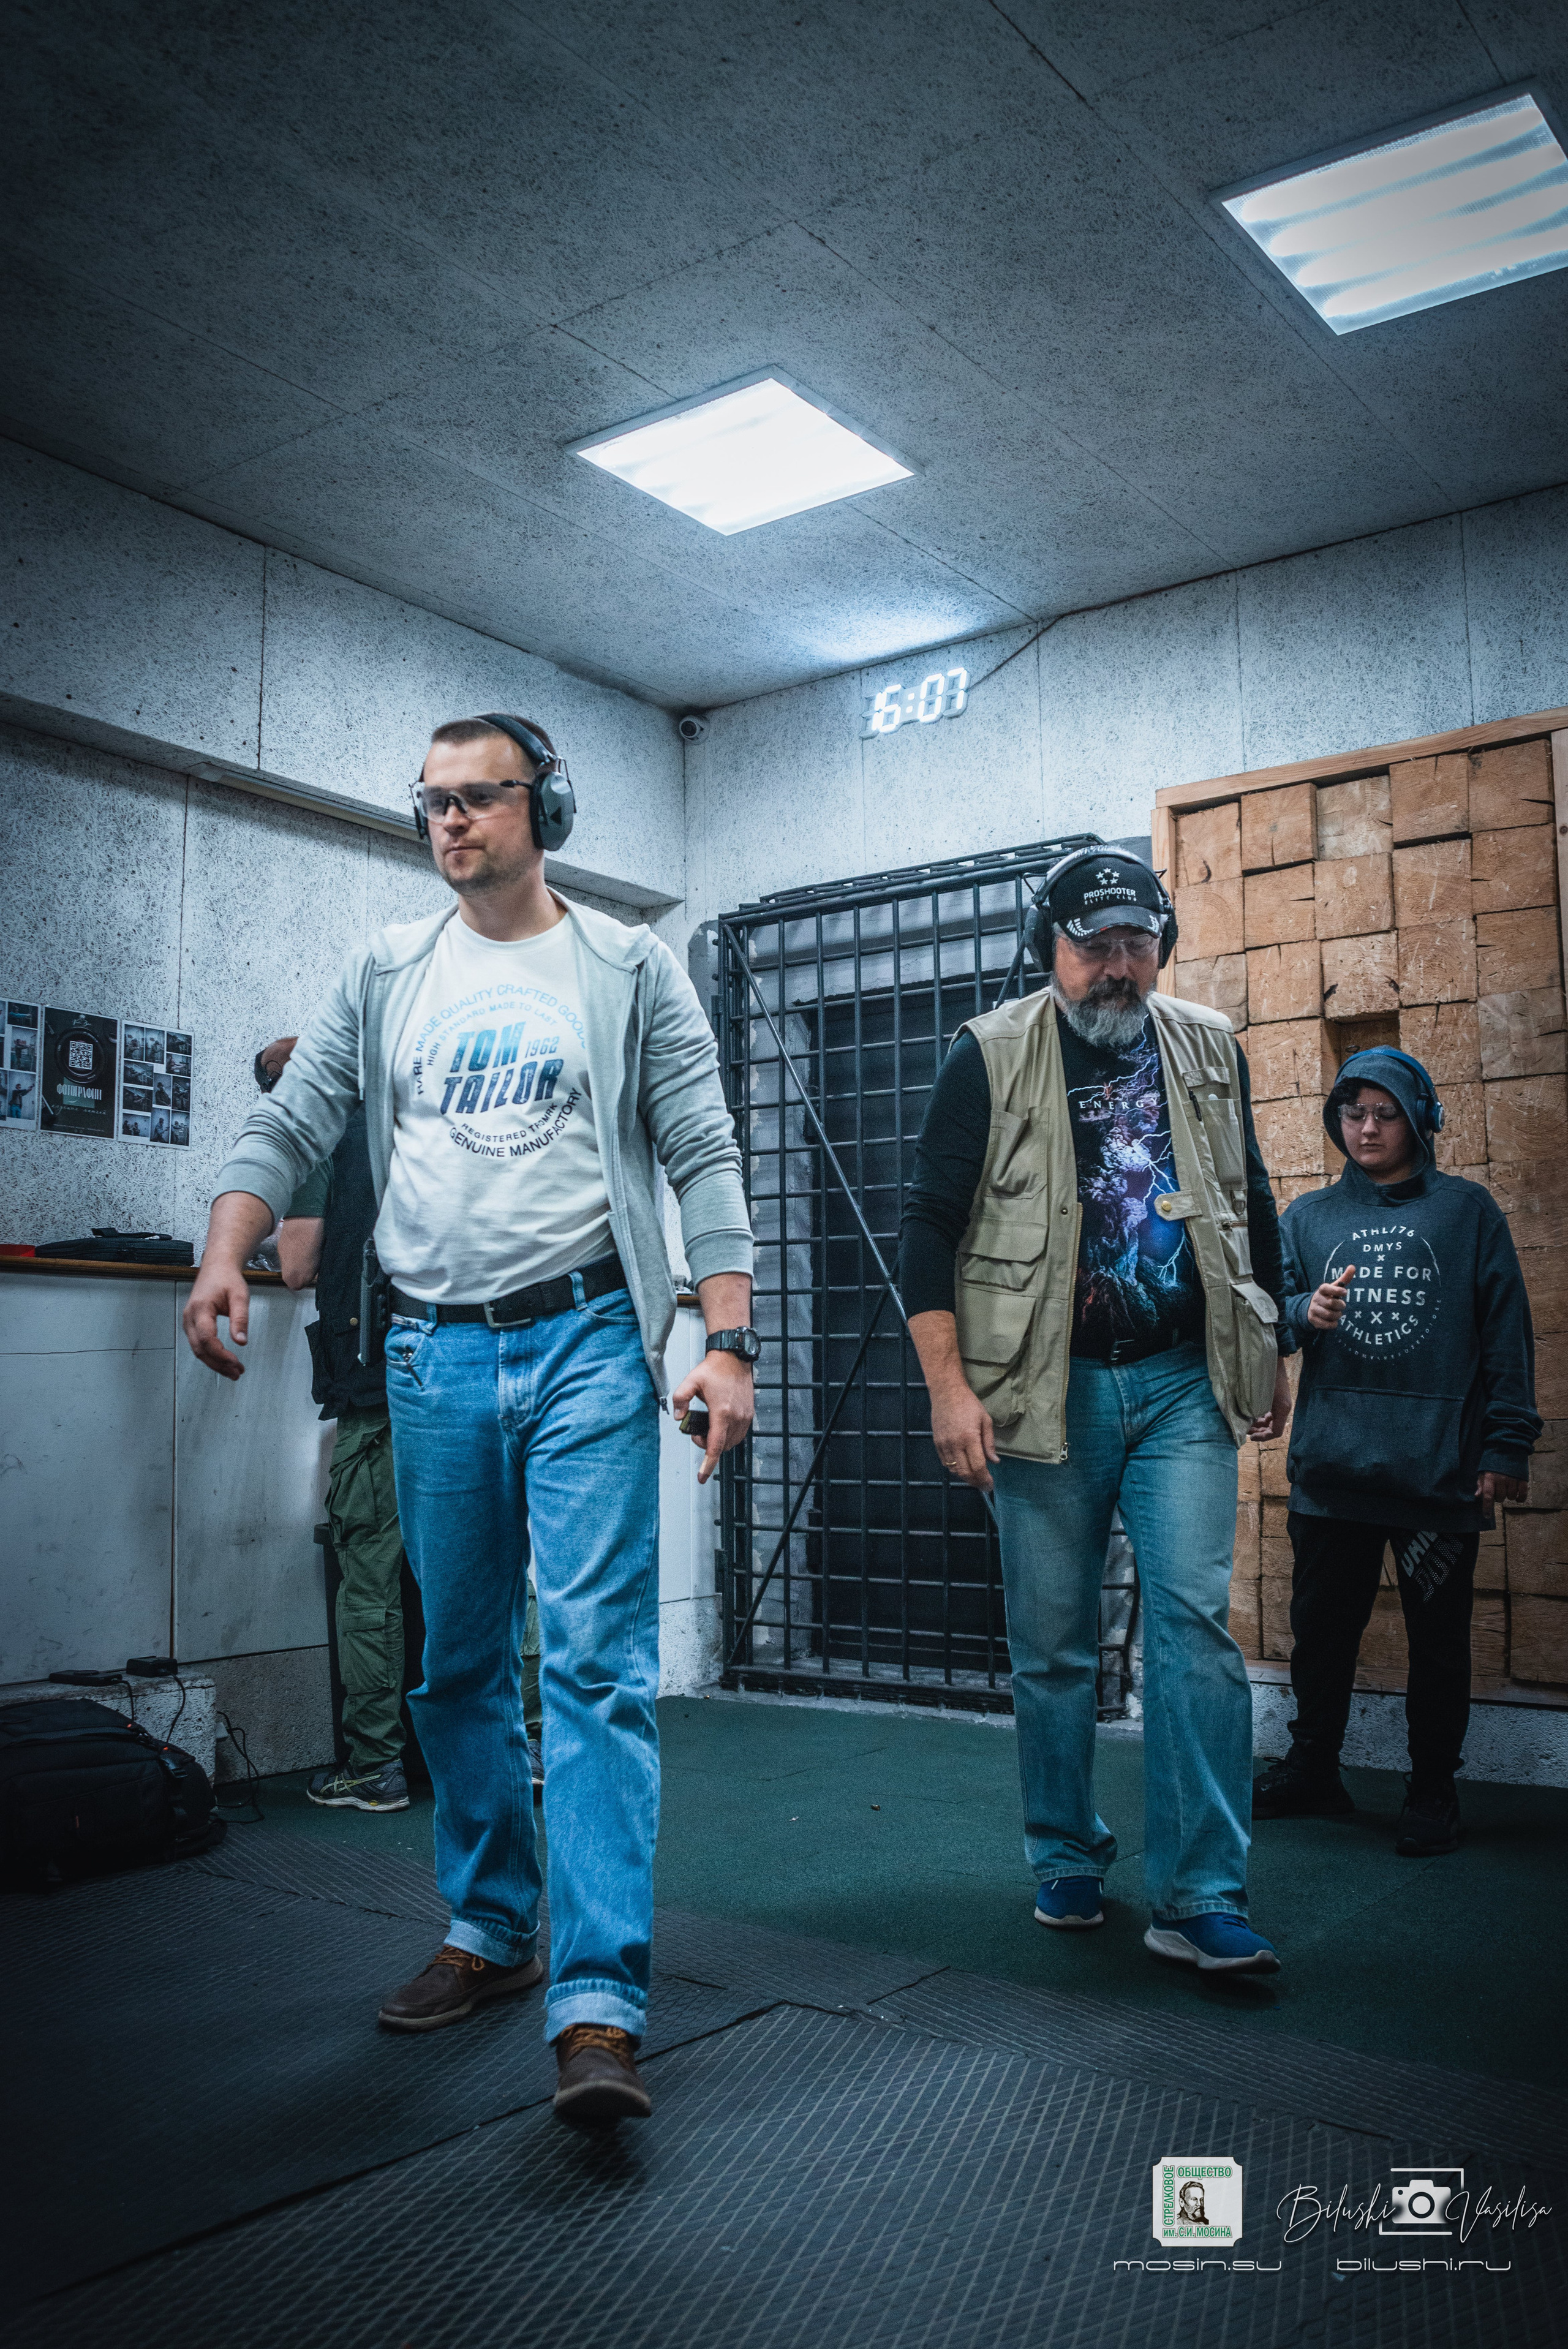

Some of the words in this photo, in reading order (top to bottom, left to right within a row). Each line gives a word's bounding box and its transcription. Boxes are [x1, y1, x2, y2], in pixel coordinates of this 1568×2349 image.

[1084, 888, 1136, 900] PROSHOOTER
[416, 1016, 442, 1052] MADE
[440, 987, 492, 1019] QUALITY
[497, 984, 558, 1007] CRAFTED
[426, 1042, 441, 1066] HIGH
[439, 1008, 486, 1041] STANDARD
[519, 1002, 532, 1012] TO
[450, 1021, 526, 1073] TOM
[524, 1036, 560, 1058] 1962
[440, 1058, 564, 1115] TAILOR
[1079, 1098, 1158, 1110] ENERGY
[450, 1127, 505, 1158] GENUINE
[510, 1087, 582, 1157] MANUFACTORY
[461, 1123, 527, 1143] REGISTERED
[1352, 1225, 1415, 1240] ATHL/76
[1363, 1242, 1403, 1252] DMYS
[1331, 1266, 1384, 1280] MDE
[1394, 1266, 1431, 1281] FOR
[1346, 1288, 1427, 1306] ITNESS
[1339, 1314, 1419, 1345] ATHLETICS
